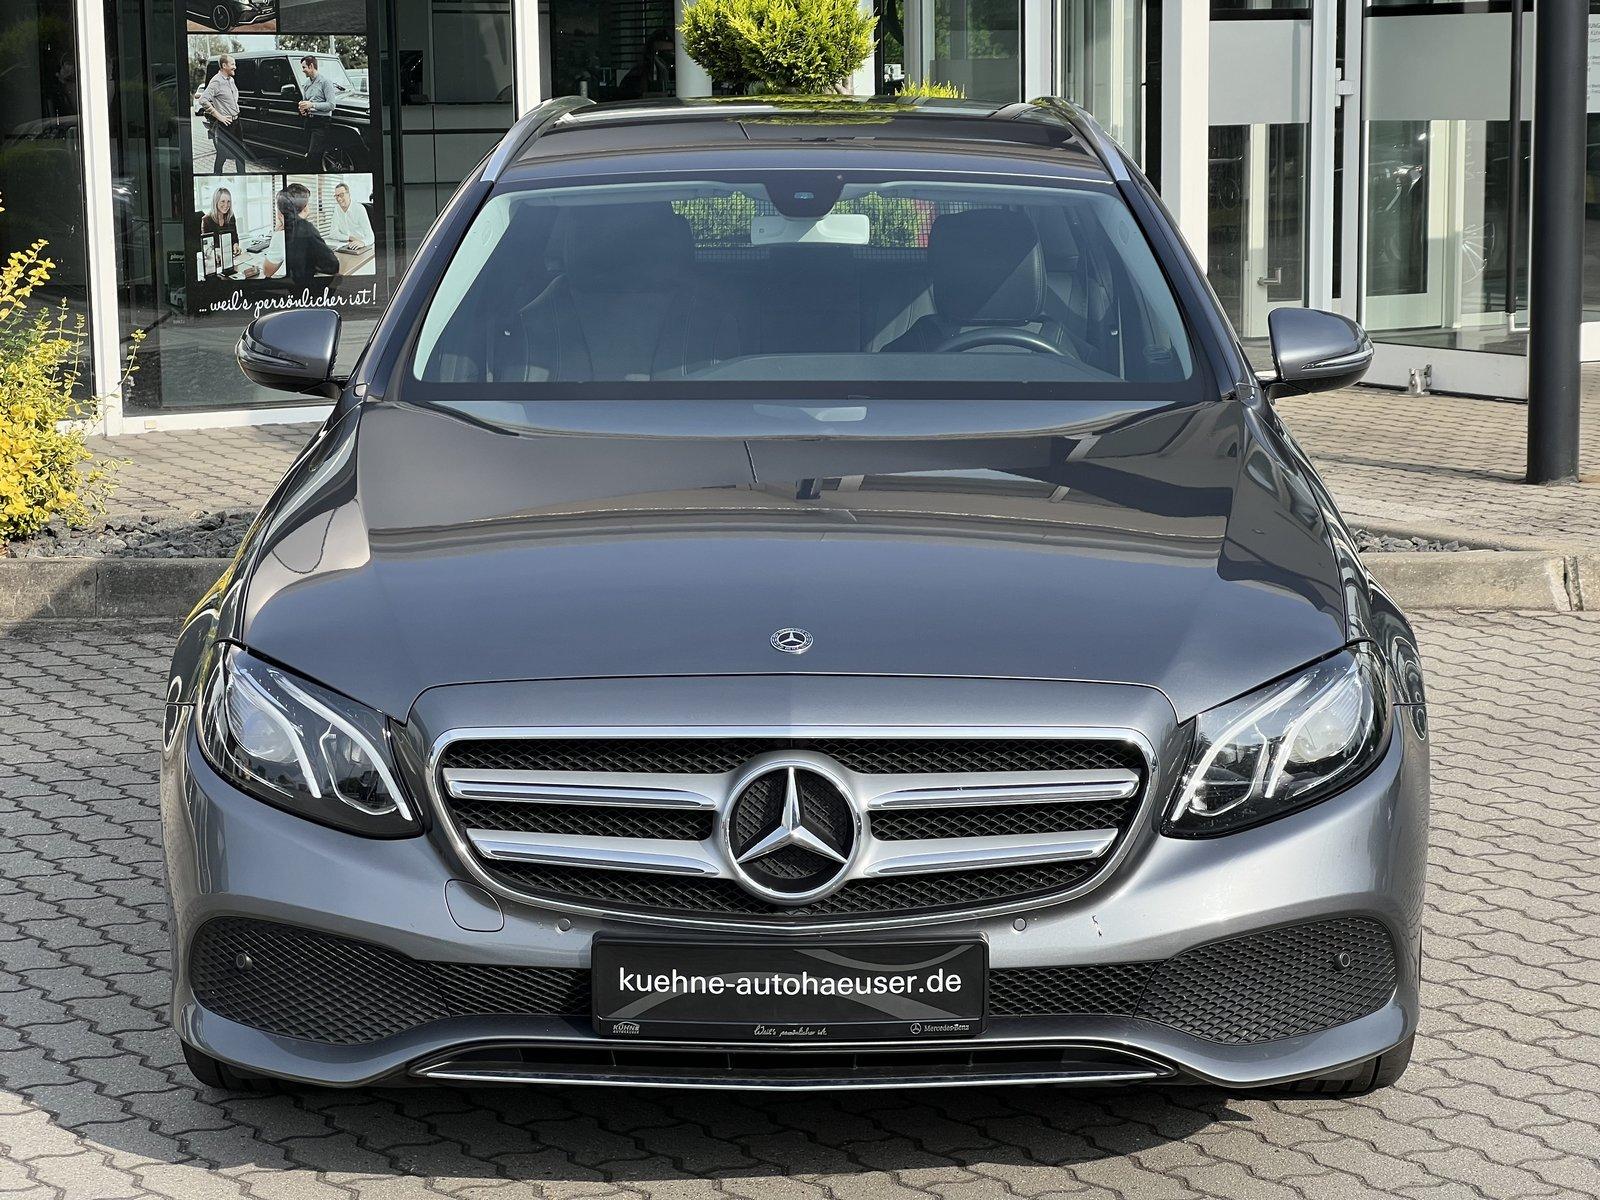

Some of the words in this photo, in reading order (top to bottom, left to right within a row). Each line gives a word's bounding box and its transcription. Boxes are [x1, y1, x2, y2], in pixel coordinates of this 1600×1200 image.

[210, 289, 252, 311] weil's
[254, 286, 347, 318] persönlicher
[349, 283, 377, 305] ist!
[619, 967, 962, 996] kuehne-autohaeuser.de
